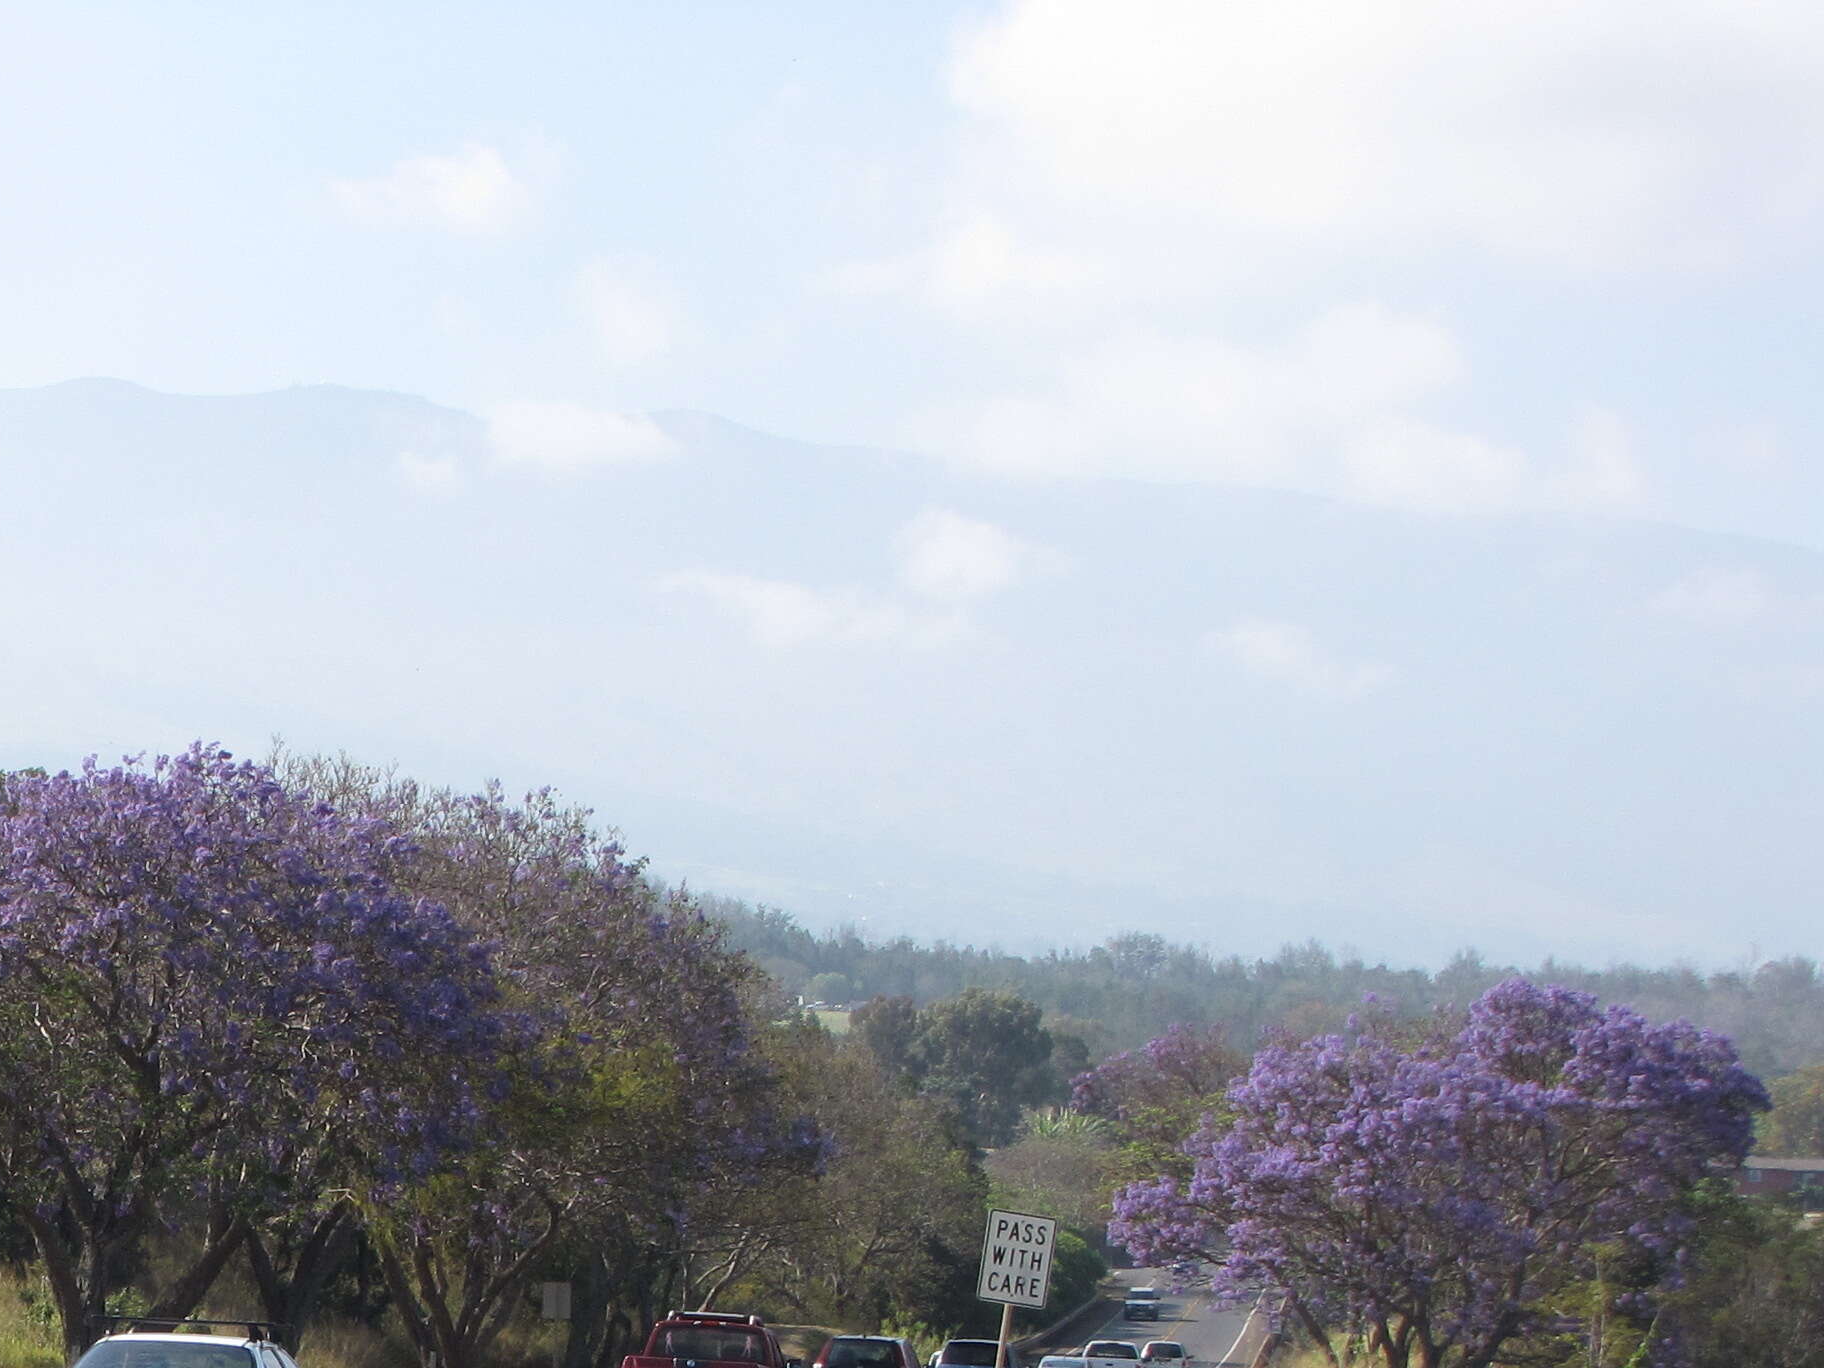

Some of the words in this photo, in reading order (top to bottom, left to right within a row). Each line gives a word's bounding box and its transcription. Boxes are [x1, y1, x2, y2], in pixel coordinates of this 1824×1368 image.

[996, 1219, 1048, 1246] PASS
[992, 1245, 1044, 1272] WITH
[987, 1271, 1042, 1298] CARE
